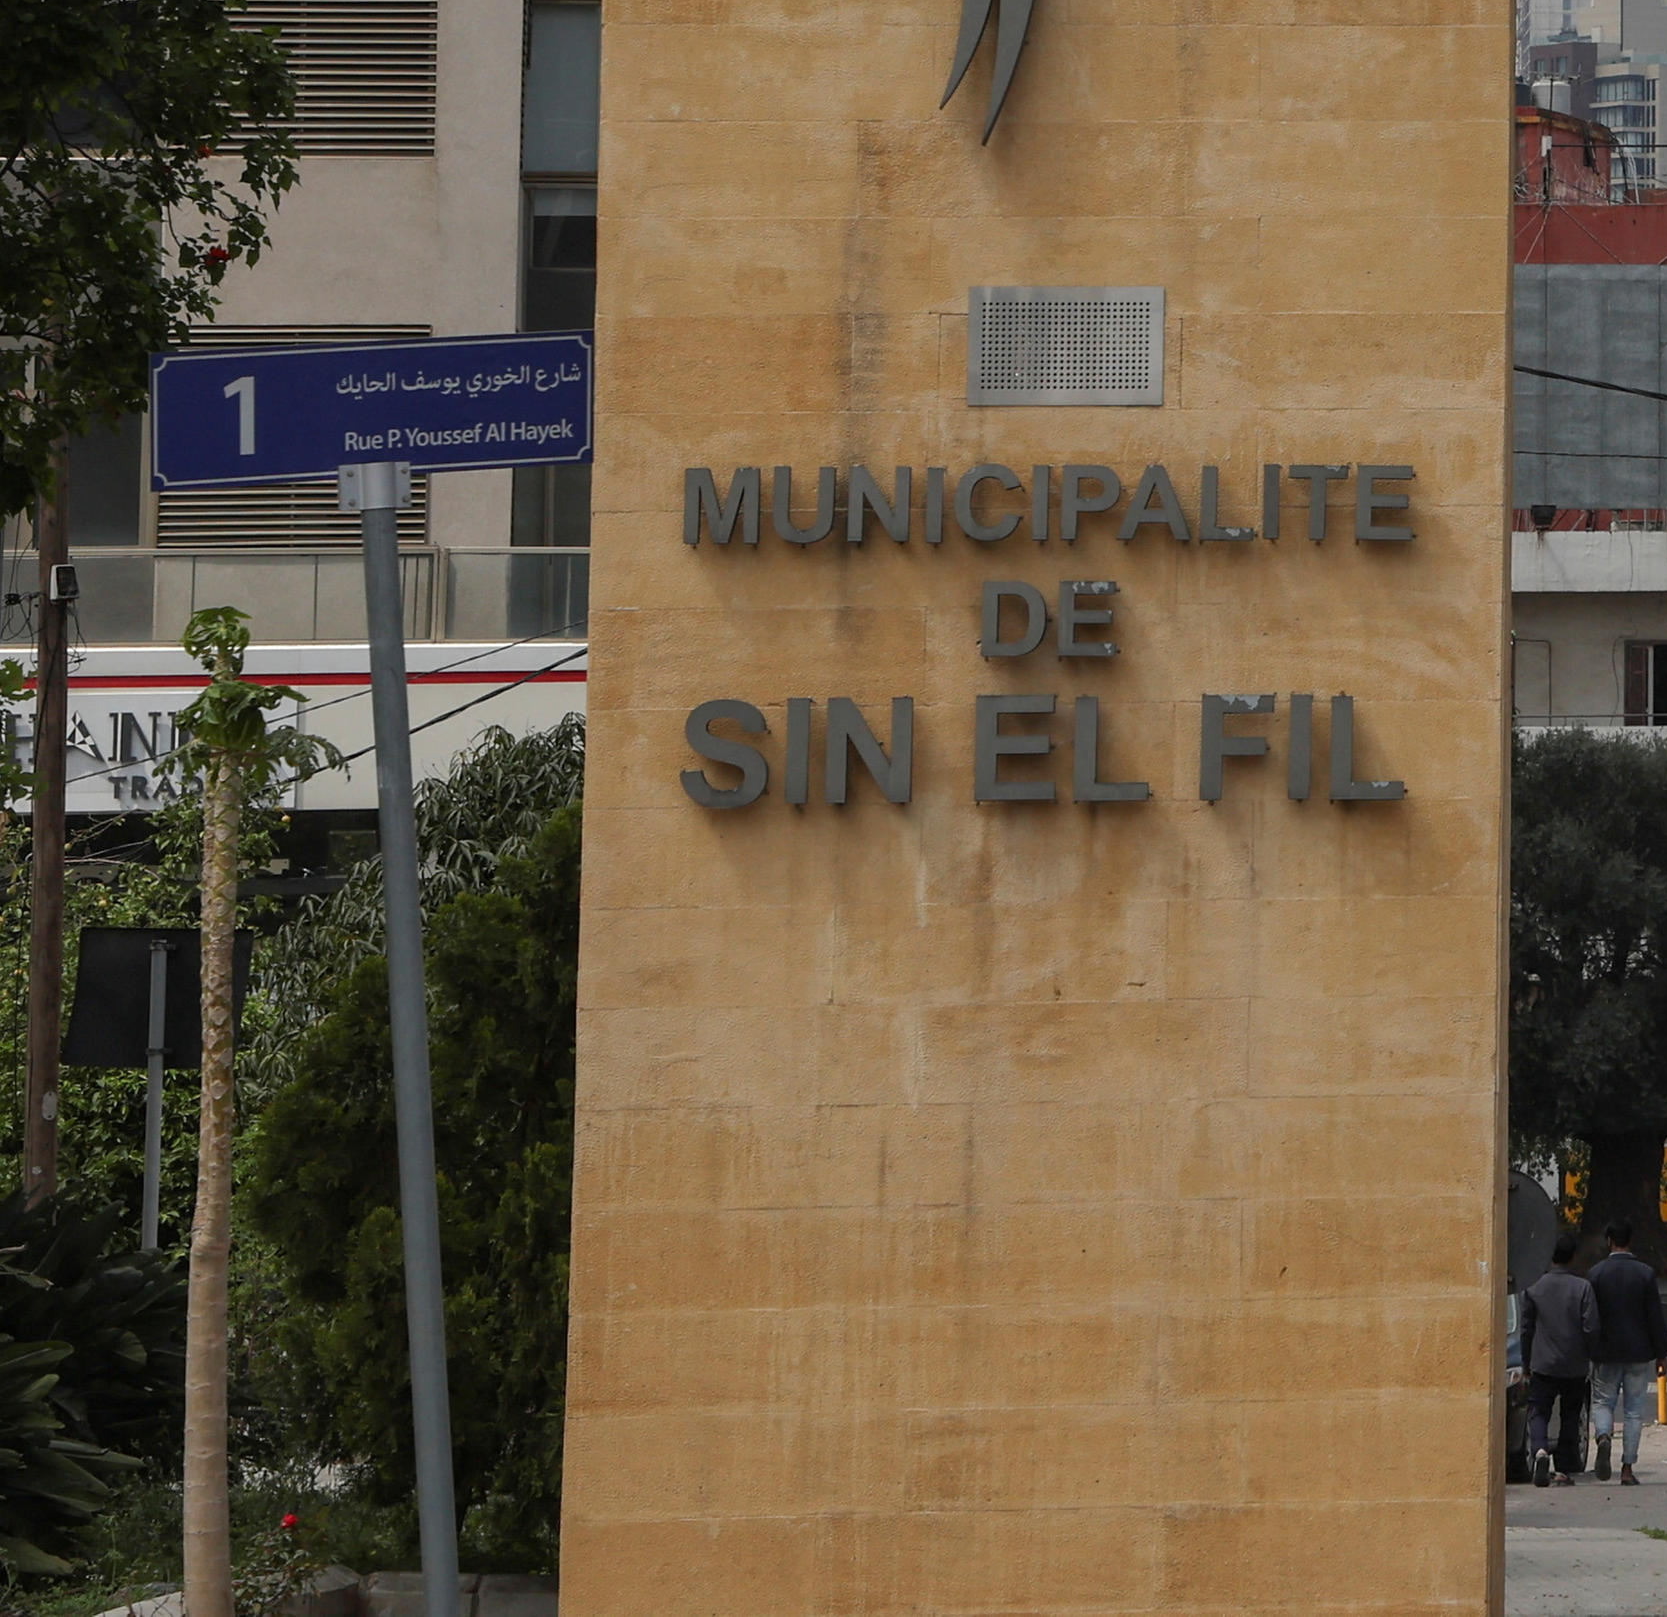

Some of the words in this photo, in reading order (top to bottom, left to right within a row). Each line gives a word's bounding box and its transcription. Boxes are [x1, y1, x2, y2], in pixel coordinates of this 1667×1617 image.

[336, 372, 396, 400] الحايك
[401, 371, 461, 395] يوسف
[466, 365, 530, 397] الخوري
[535, 363, 581, 392] شارع
[223, 375, 256, 456] 1
[345, 432, 383, 451] Rue
[387, 429, 402, 448] P.
[405, 422, 484, 447] Youssef
[485, 421, 506, 443] Al
[510, 418, 574, 445] Hayek
[683, 465, 1415, 544] MUNICIPALITE
[981, 581, 1118, 657] DE
[680, 696, 913, 808] SIN
[974, 694, 1151, 801] EL
[1200, 692, 1405, 801] FIL
